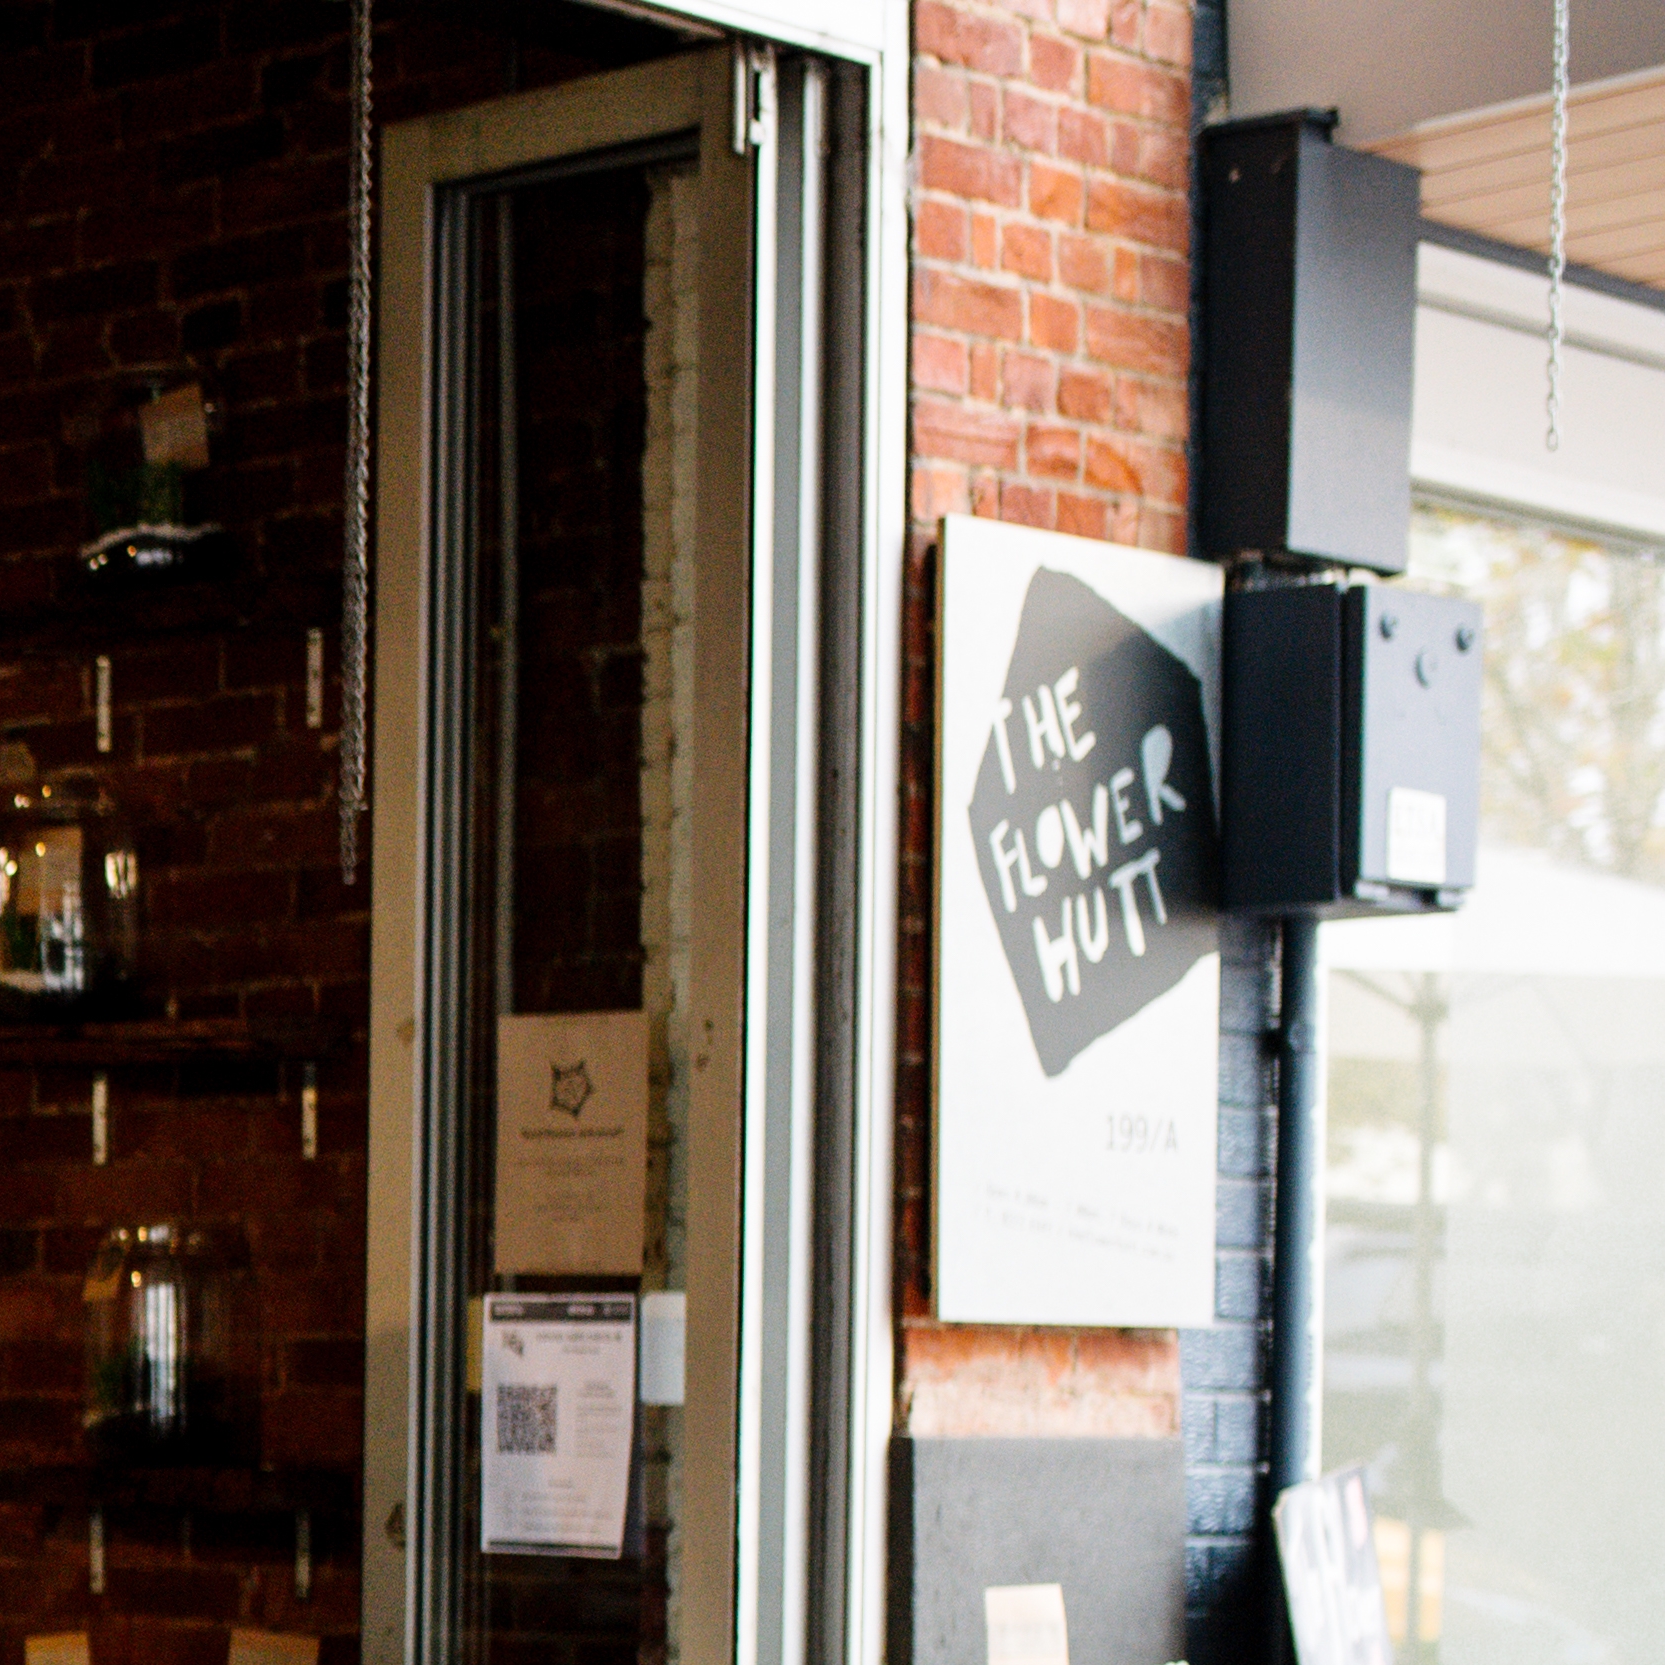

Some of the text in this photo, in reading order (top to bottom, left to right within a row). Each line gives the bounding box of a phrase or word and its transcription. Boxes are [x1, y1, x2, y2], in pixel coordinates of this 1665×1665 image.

[990, 665, 1098, 797] THE
[988, 723, 1188, 914] FLOWER
[1031, 847, 1169, 1004] HUTT
